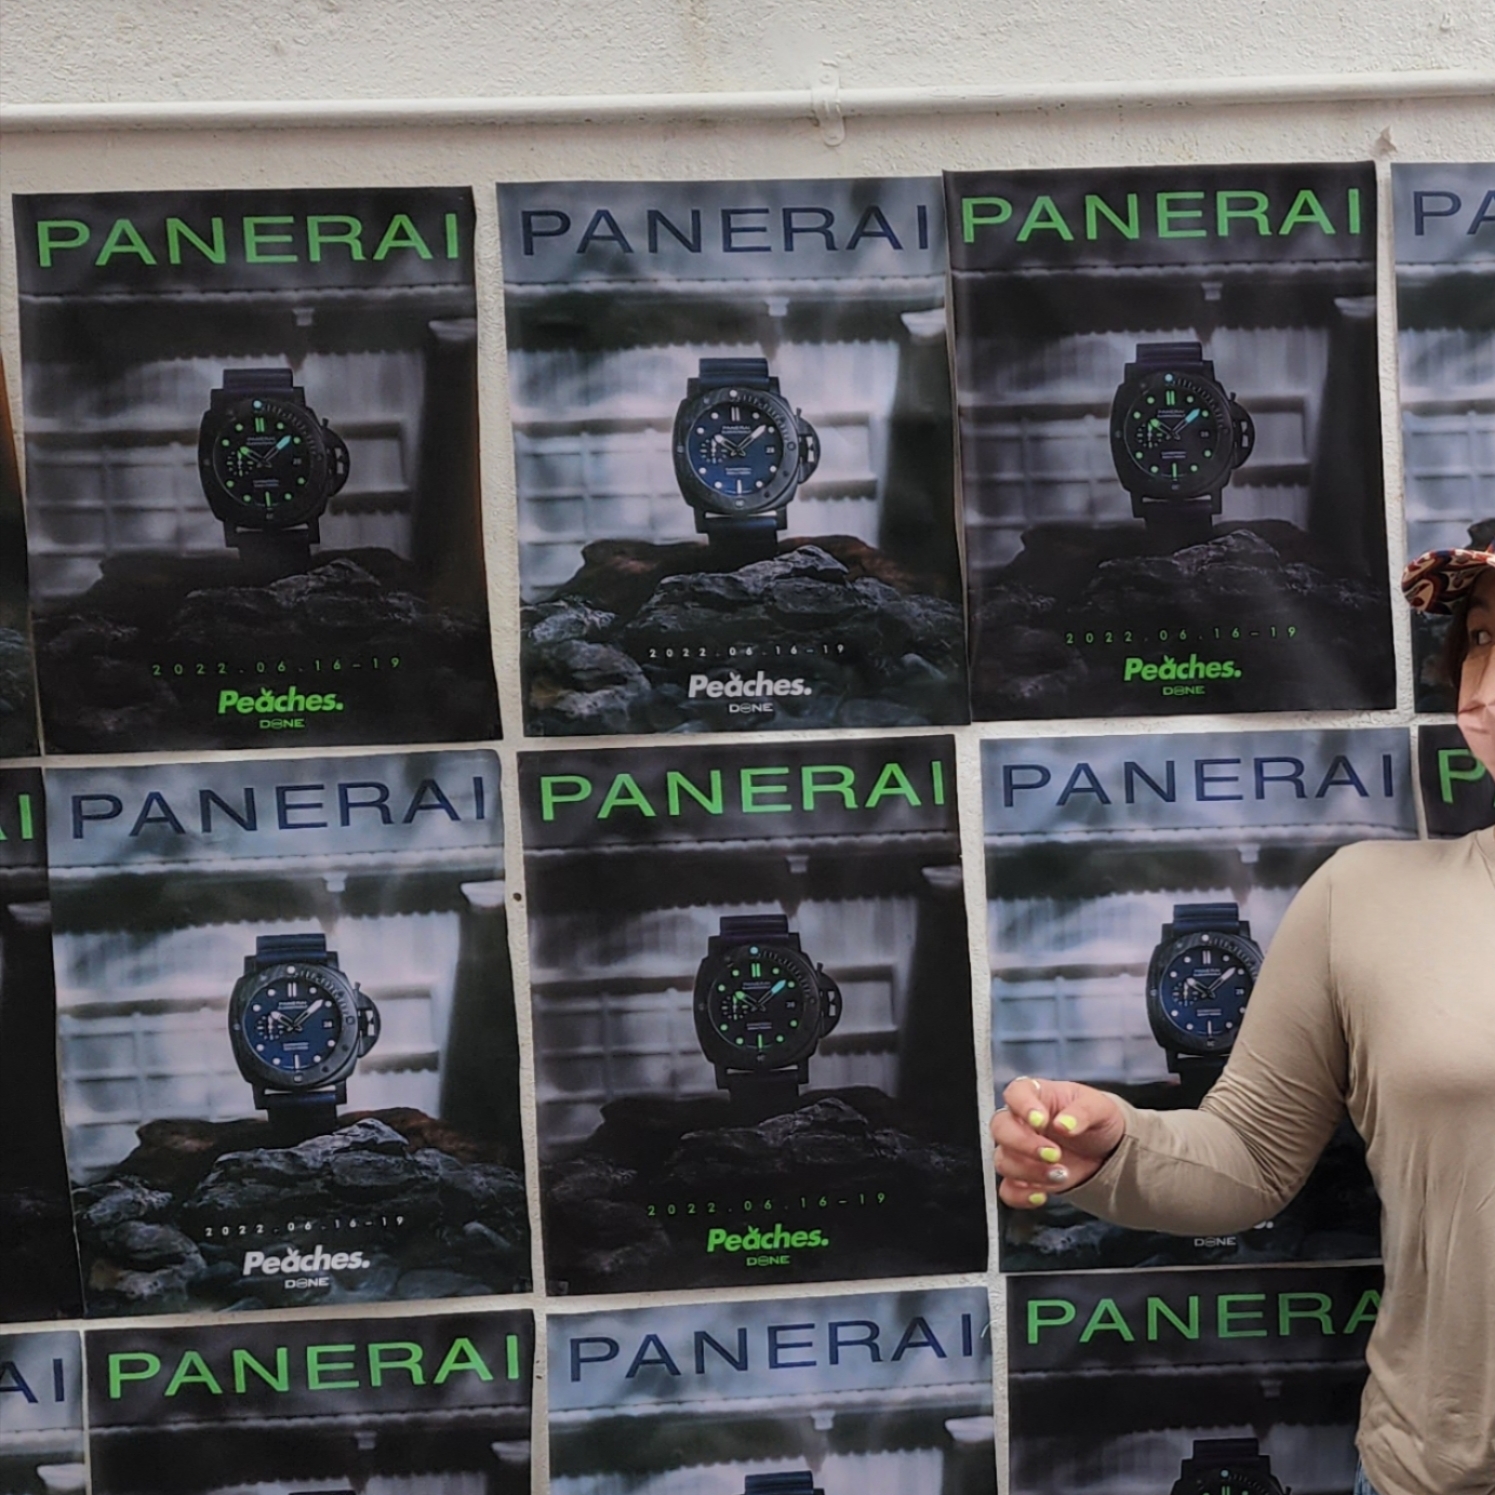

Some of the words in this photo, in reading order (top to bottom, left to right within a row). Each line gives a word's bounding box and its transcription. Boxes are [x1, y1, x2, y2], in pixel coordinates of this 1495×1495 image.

[36, 212, 460, 268] PANERAI
[520, 207, 929, 255] PANERAI
[961, 188, 1362, 244] PANERAI
[72, 777, 485, 838] PANERAI
[540, 760, 946, 823] PANERAI
[1003, 754, 1393, 807] PANERAI
[1026, 1289, 1381, 1345] PANERA
[107, 1334, 520, 1400] PANERAI
[570, 1312, 973, 1381] PANERAI
